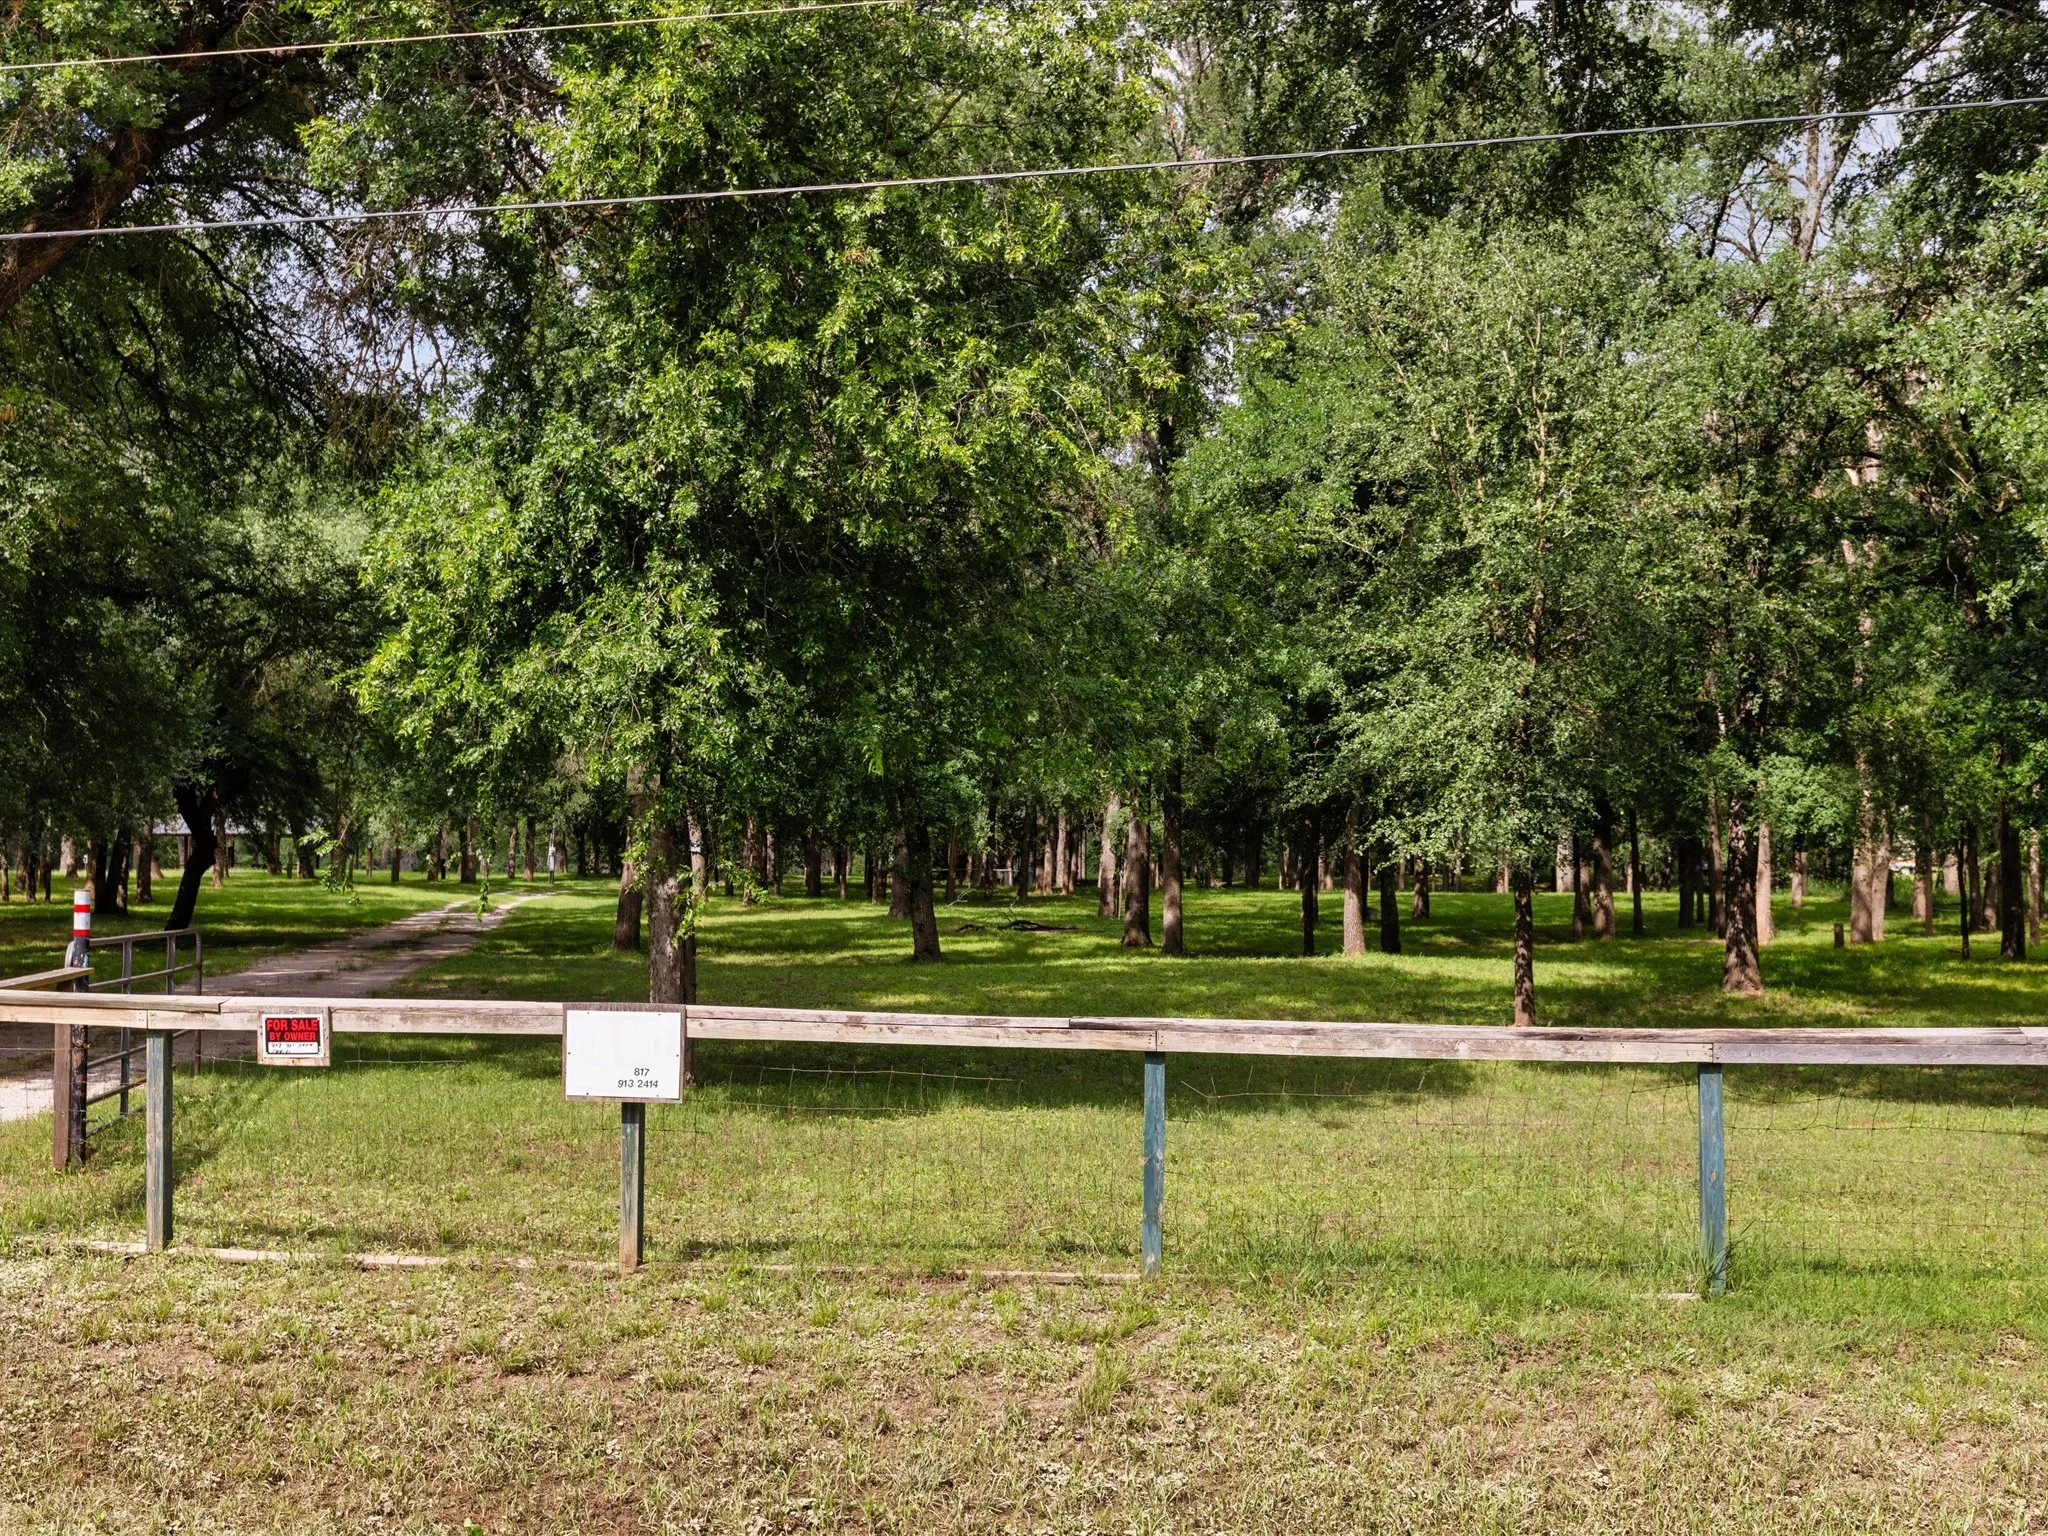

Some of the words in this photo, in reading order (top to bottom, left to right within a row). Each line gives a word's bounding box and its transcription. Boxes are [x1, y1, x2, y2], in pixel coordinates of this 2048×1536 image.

[267, 1019, 288, 1031] FOR
[291, 1019, 318, 1031] SALE
[269, 1032, 281, 1041] BY
[284, 1032, 316, 1041] OWNER
[634, 1067, 650, 1076] 817
[617, 1079, 634, 1088] 913
[637, 1080, 658, 1088] 2414
